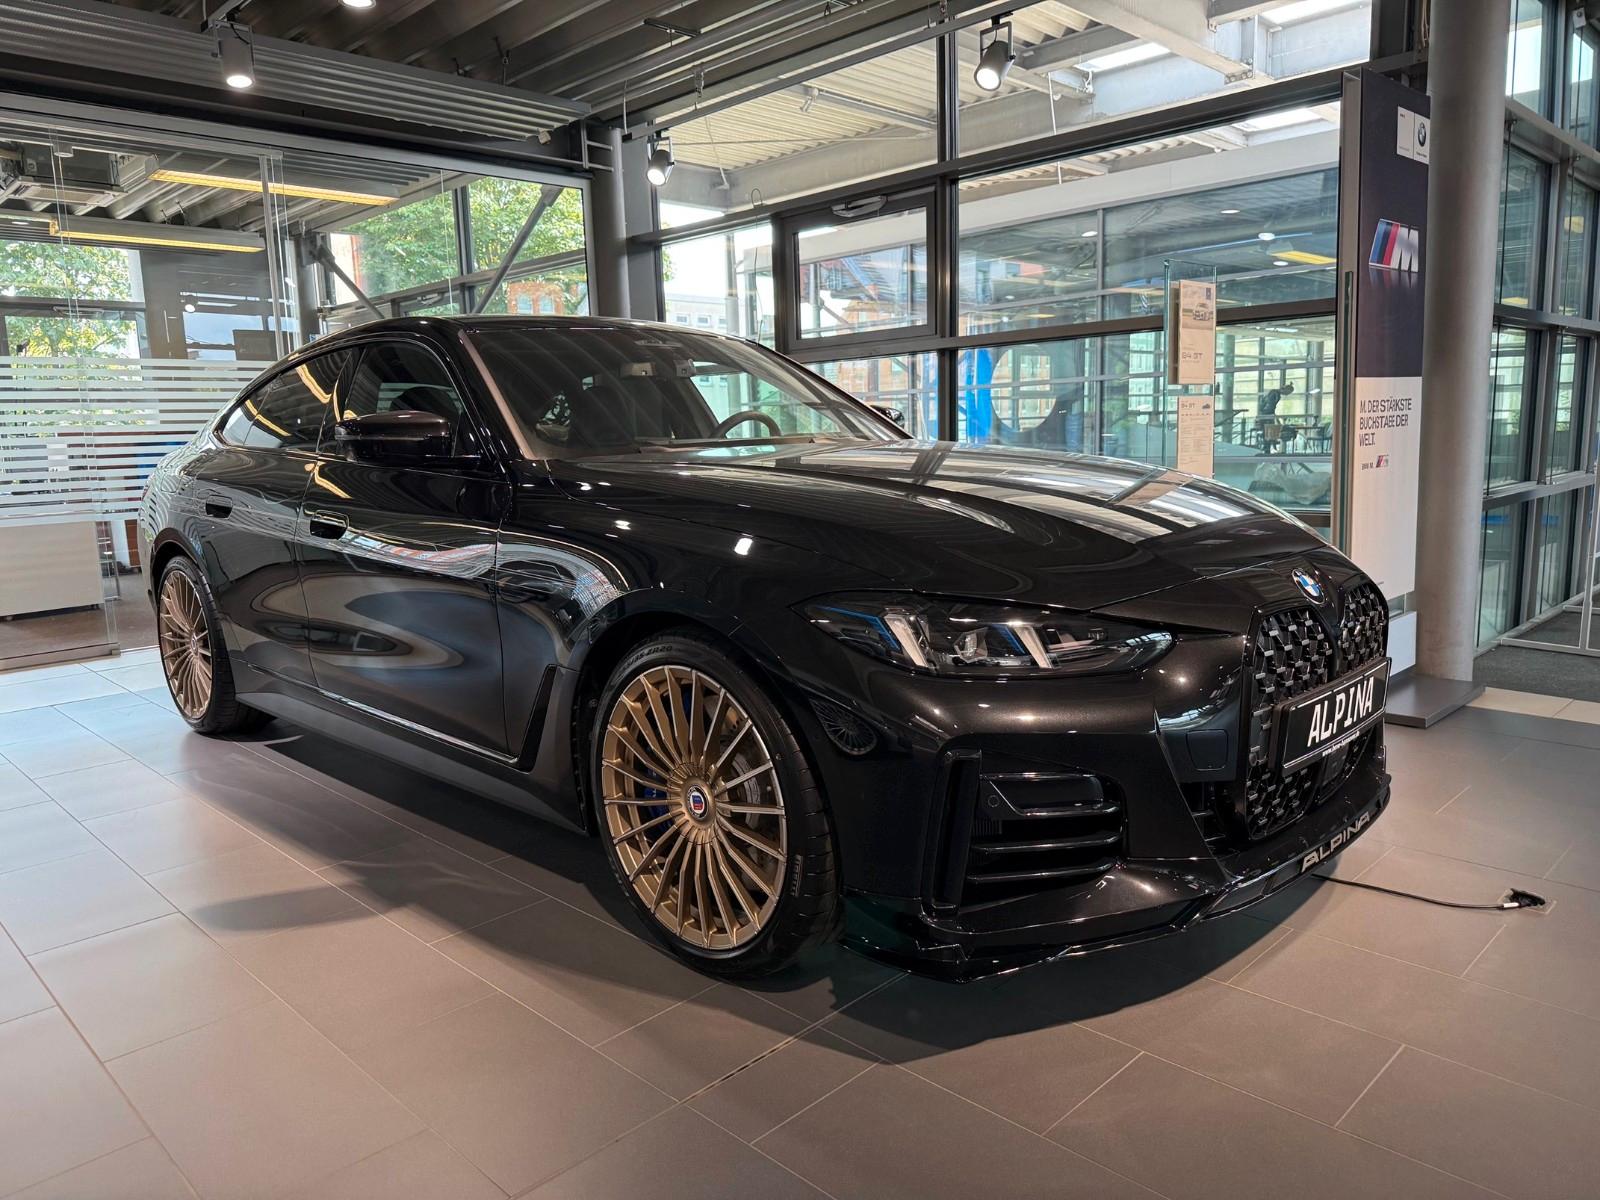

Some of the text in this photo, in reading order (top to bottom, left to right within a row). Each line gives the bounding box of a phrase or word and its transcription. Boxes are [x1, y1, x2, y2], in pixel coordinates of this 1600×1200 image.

[1360, 414, 1409, 430] BUCHSTABE DER
[1367, 400, 1379, 413] DER
[1380, 396, 1412, 413] STÄRKSTE
[1307, 676, 1375, 748] ALPINA
[1301, 811, 1370, 873] ALPINA
